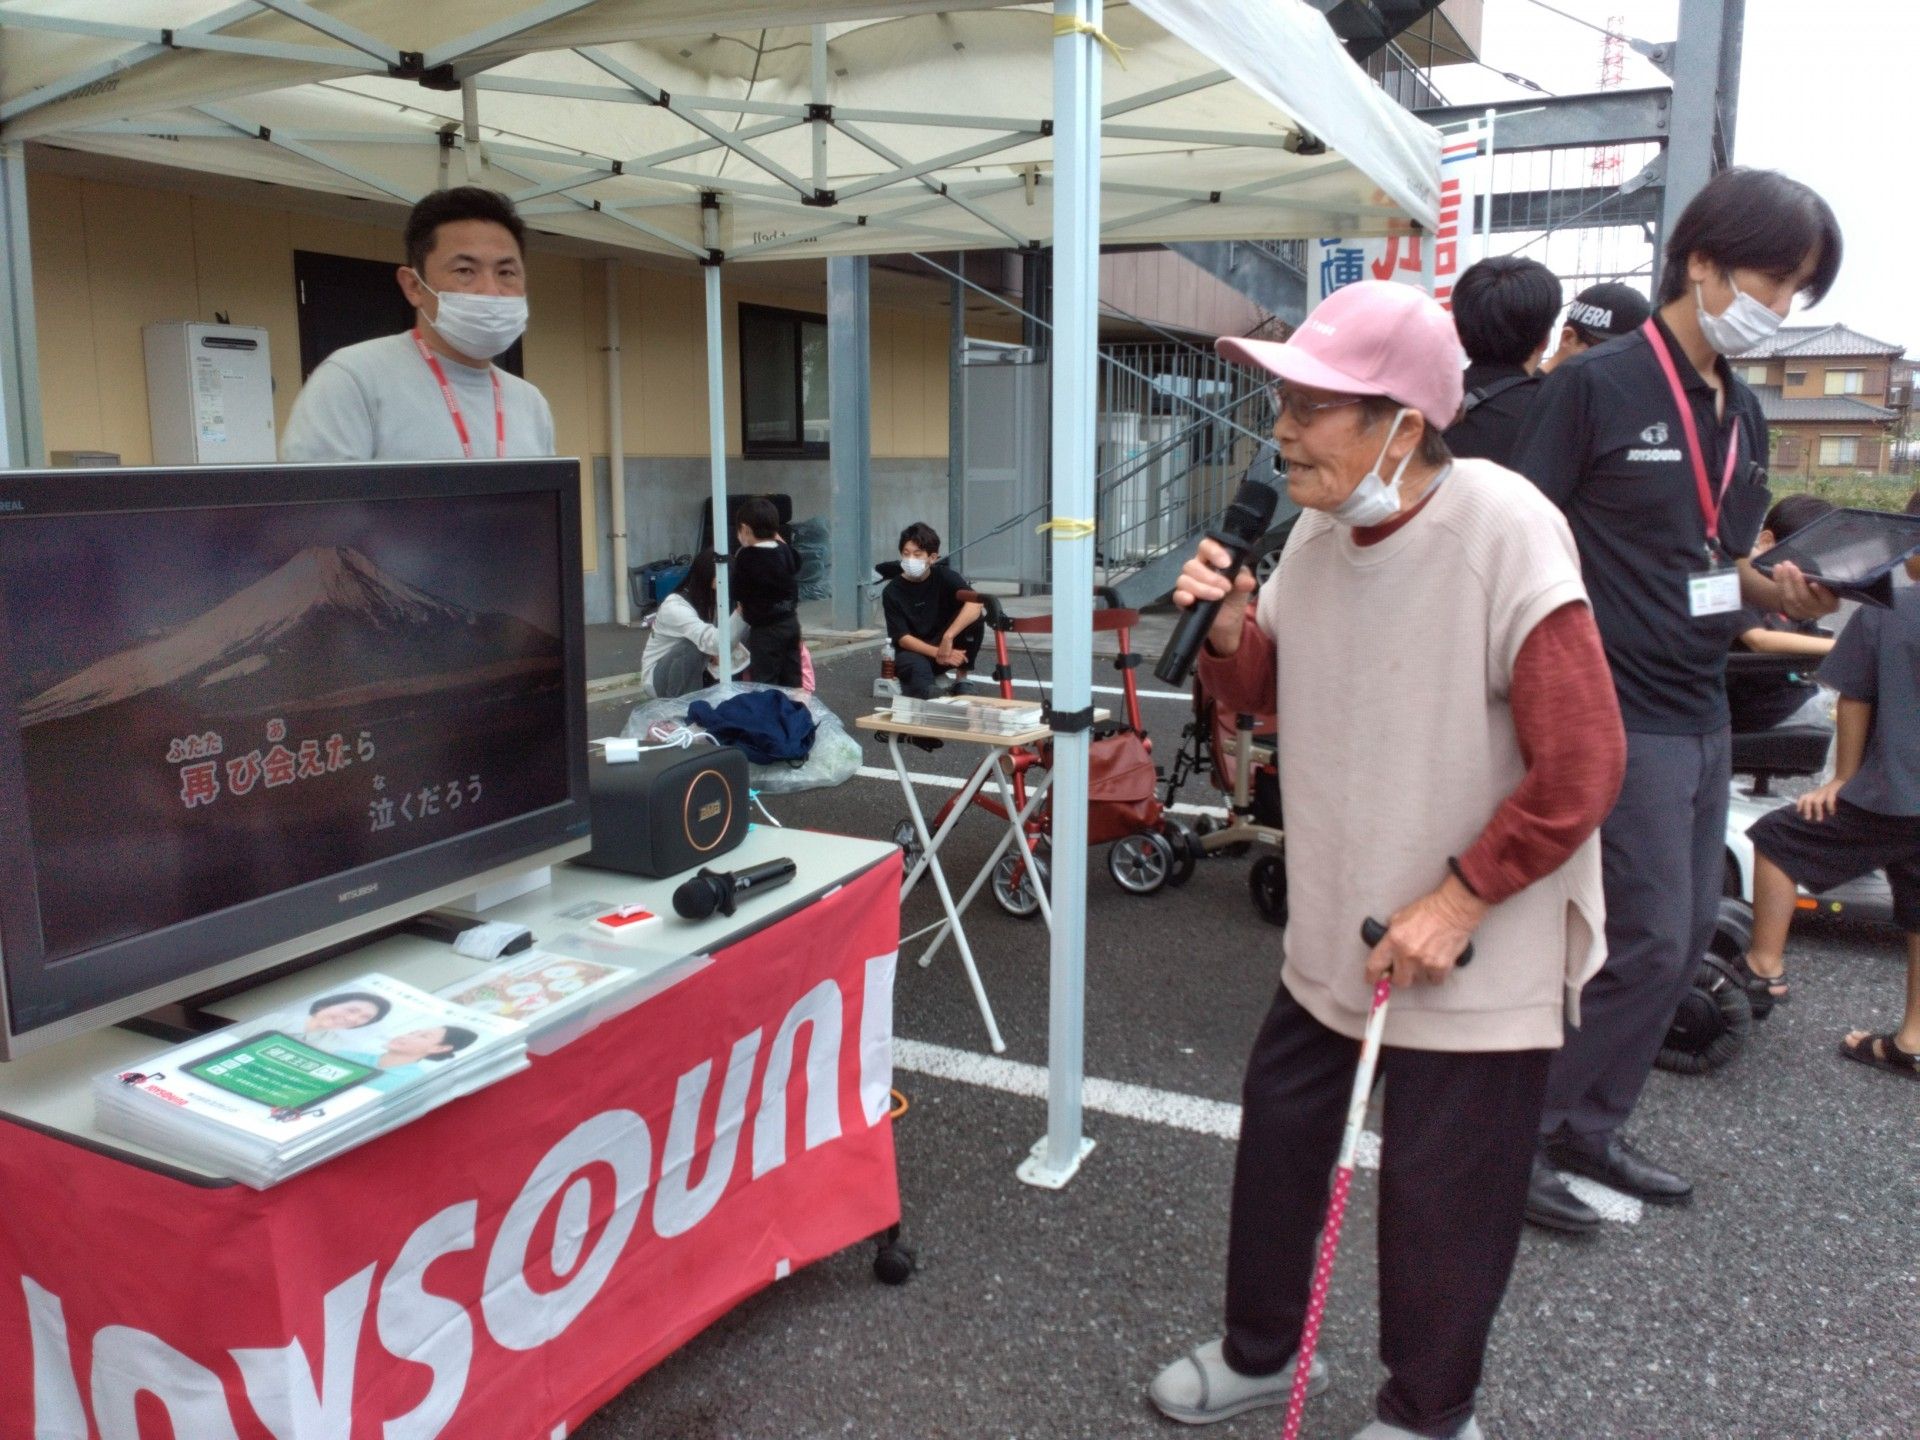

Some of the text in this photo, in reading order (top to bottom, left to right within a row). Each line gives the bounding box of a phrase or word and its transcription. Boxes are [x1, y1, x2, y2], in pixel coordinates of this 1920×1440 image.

[166, 731, 223, 763] ふたた
[267, 718, 286, 742] あ
[180, 731, 375, 809] 再び会えたら
[368, 774, 482, 832] 泣くだろう
